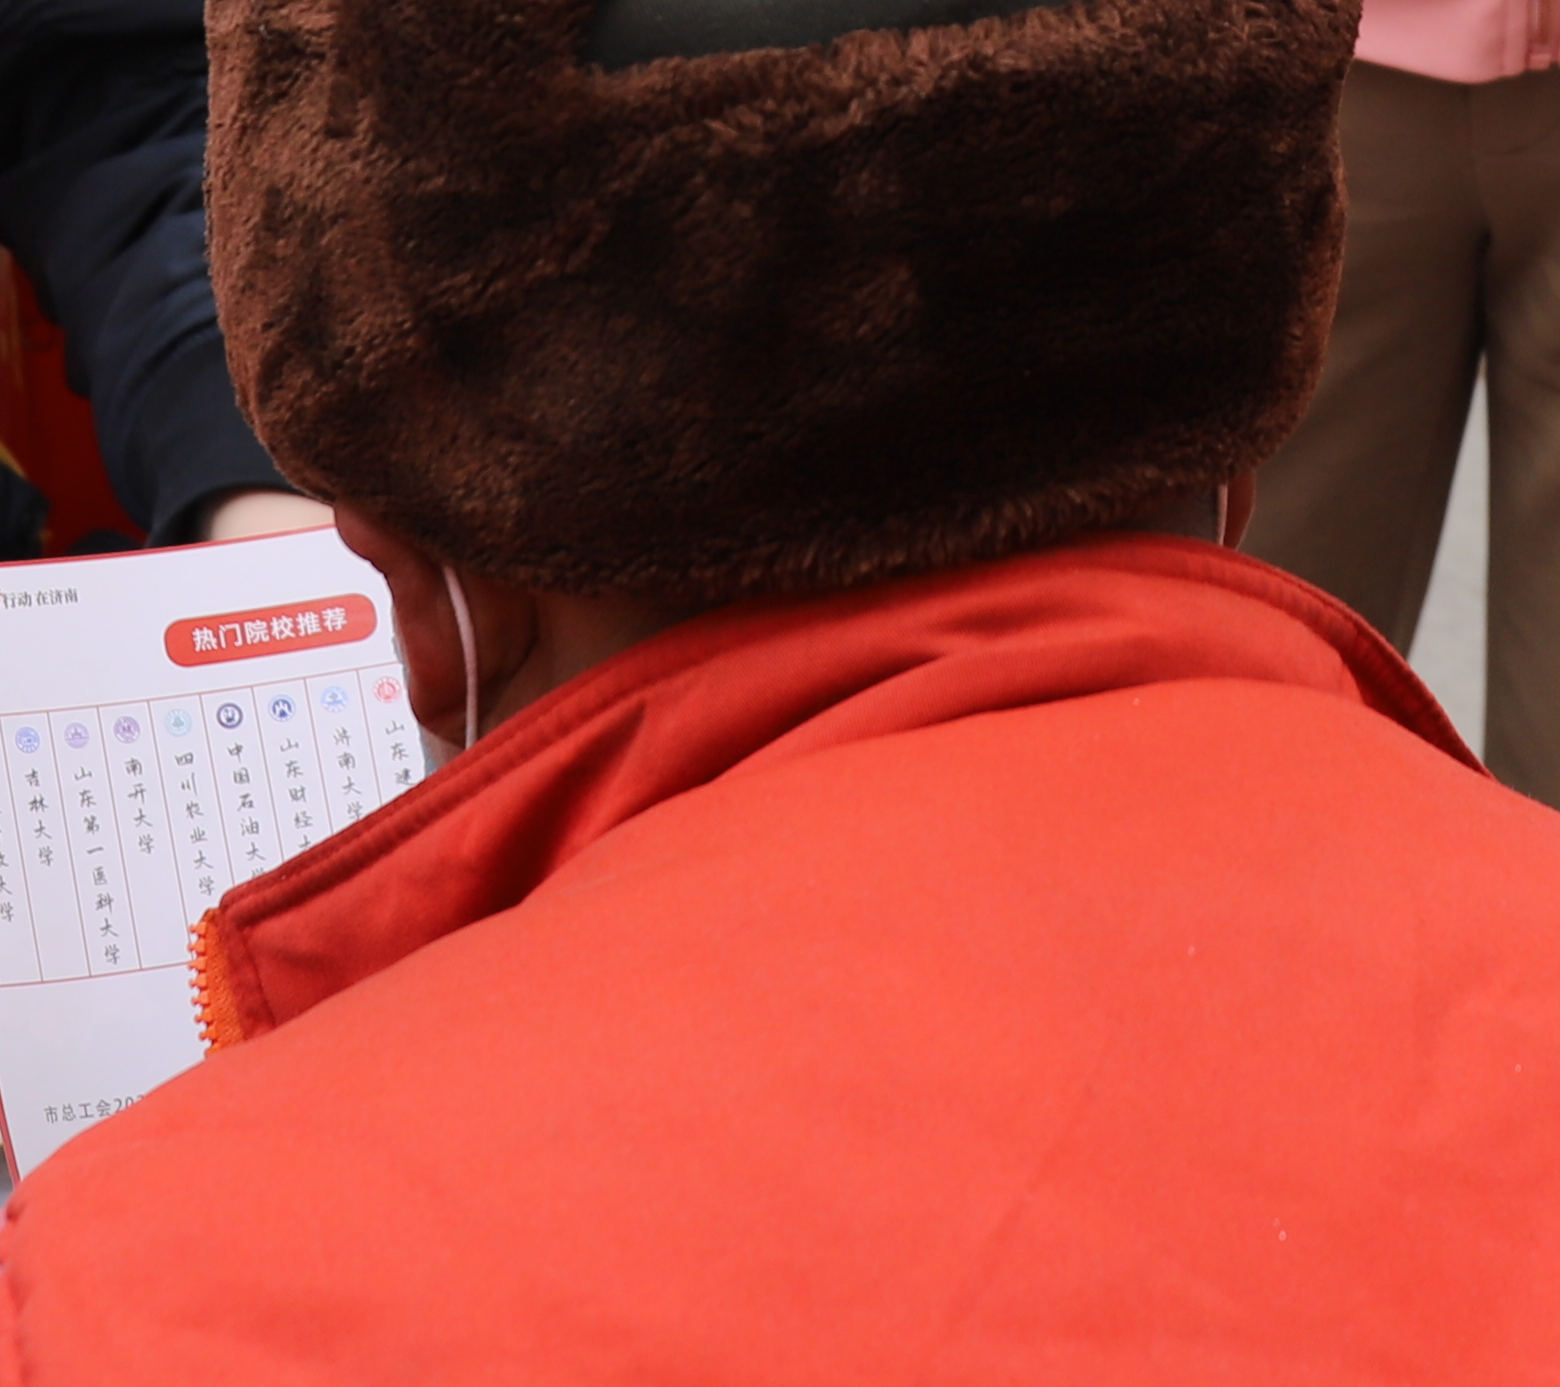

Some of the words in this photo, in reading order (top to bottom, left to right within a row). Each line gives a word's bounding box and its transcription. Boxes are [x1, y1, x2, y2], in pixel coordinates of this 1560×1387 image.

[192, 607, 347, 653] 热门院校推荐
[24, 768, 54, 867] 吉林大学
[123, 757, 155, 855] 南开大学
[174, 751, 215, 897] 四川农业大学
[73, 767, 121, 965] 山东第一医科大学
[44, 1095, 145, 1124] 市总工会20
